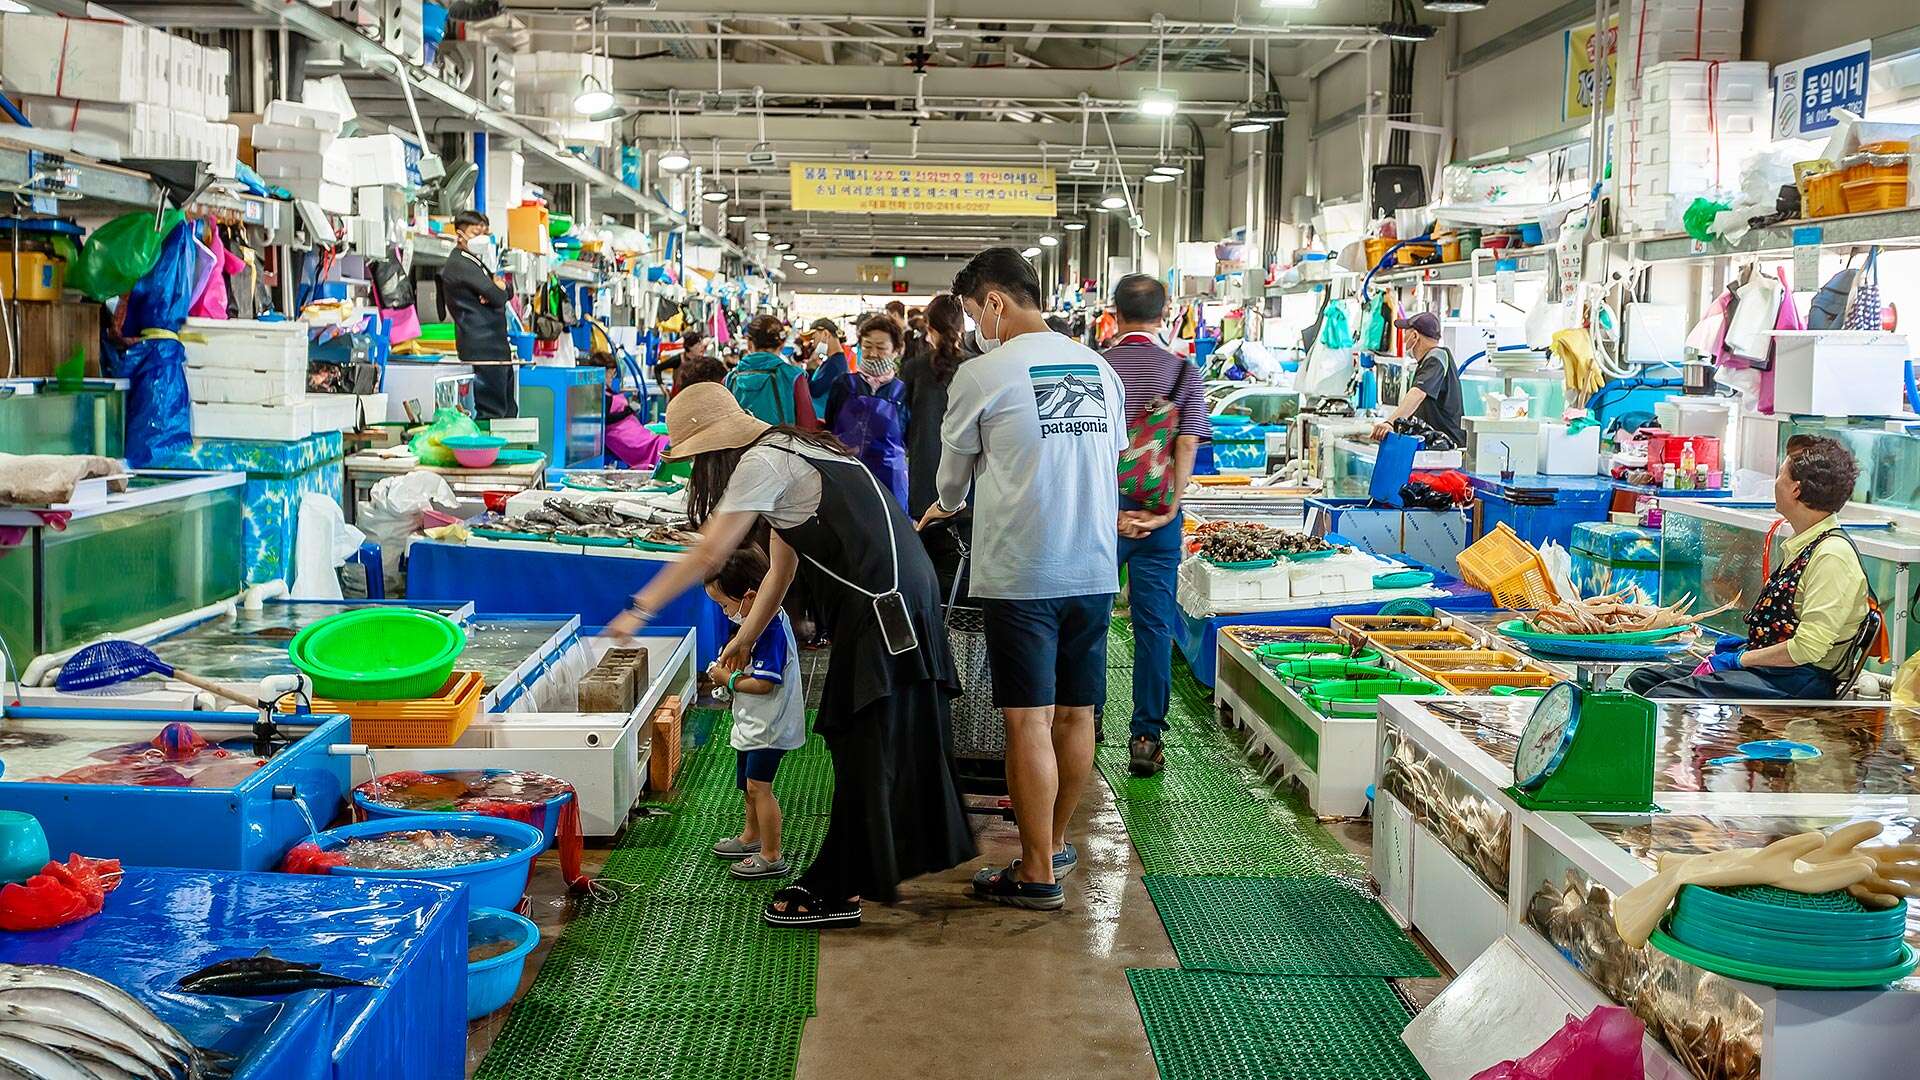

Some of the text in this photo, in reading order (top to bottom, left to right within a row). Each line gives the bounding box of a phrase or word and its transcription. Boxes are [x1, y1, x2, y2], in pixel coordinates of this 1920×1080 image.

[1805, 62, 1864, 108] 동일이네
[832, 167, 868, 181] 구매시
[872, 170, 896, 182] 상호
[899, 170, 911, 182] 및
[915, 170, 974, 184] 전화번호를
[816, 185, 836, 195] 손님
[840, 186, 885, 197] 여러분의
[890, 187, 921, 198] 불편을
[927, 188, 958, 199] 해소해
[1040, 419, 1108, 439] patagonia
